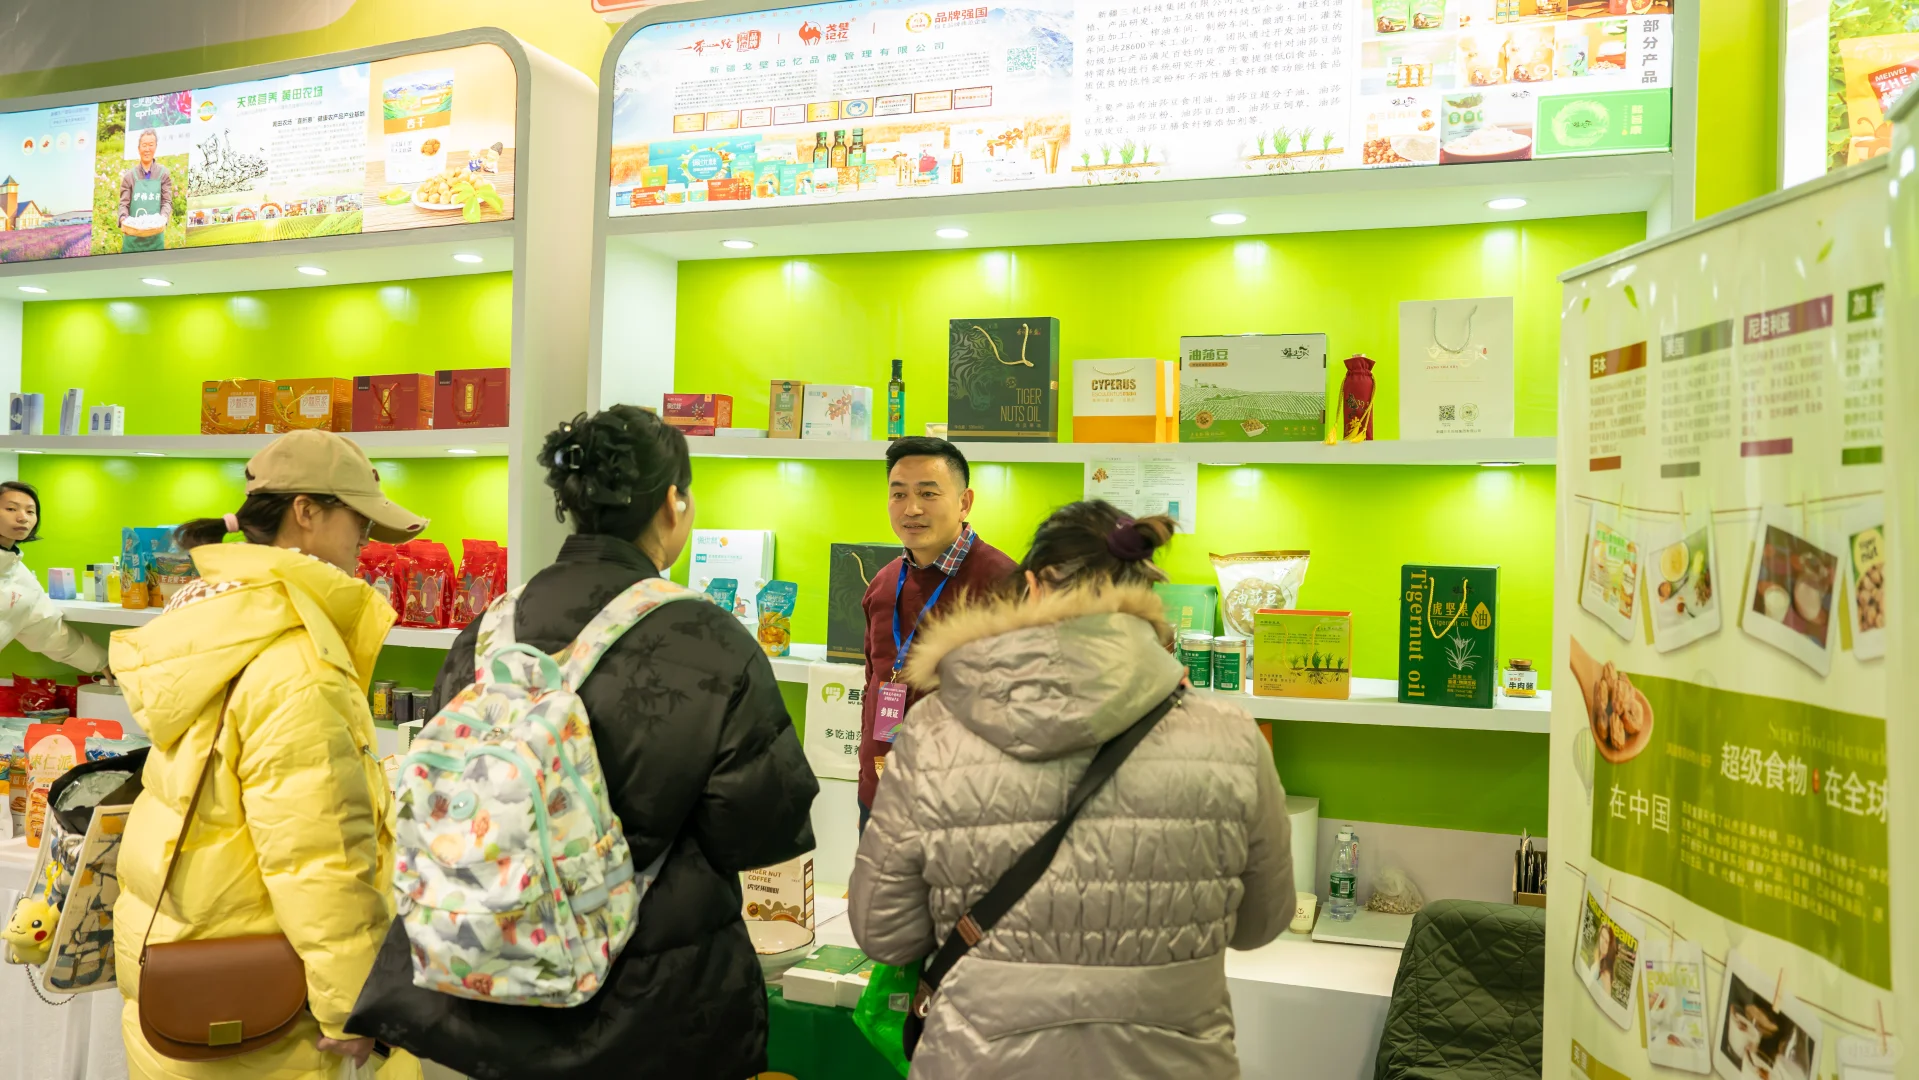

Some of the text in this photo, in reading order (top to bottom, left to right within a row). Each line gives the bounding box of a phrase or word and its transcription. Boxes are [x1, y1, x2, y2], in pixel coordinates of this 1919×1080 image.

[934, 7, 988, 23] 品牌强国
[710, 42, 944, 74] 新疆戈壁记忆品牌管理有限公司
[1641, 19, 1660, 83] 部分产品
[1875, 67, 1907, 82] MEIWEI
[237, 91, 278, 108] 天然营养
[282, 85, 324, 101] 黄田农场
[1188, 348, 1229, 361] 油莎豆
[1593, 357, 1606, 374] 日本
[1091, 379, 1137, 390] CYPERUS
[1015, 388, 1042, 405] TIGER
[1000, 405, 1042, 422] NUTS OIL
[1233, 589, 1278, 607] 油莎豆
[1405, 569, 1427, 661] Tigernut
[1432, 602, 1488, 627] 虎坚果 油
[848, 688, 865, 701] 吾
[880, 707, 899, 718] 参展证
[1720, 741, 1808, 796] 超级食物
[1824, 766, 1888, 824] 在全球
[1608, 783, 1671, 834] 在中国
[748, 874, 772, 883] COFFEE
